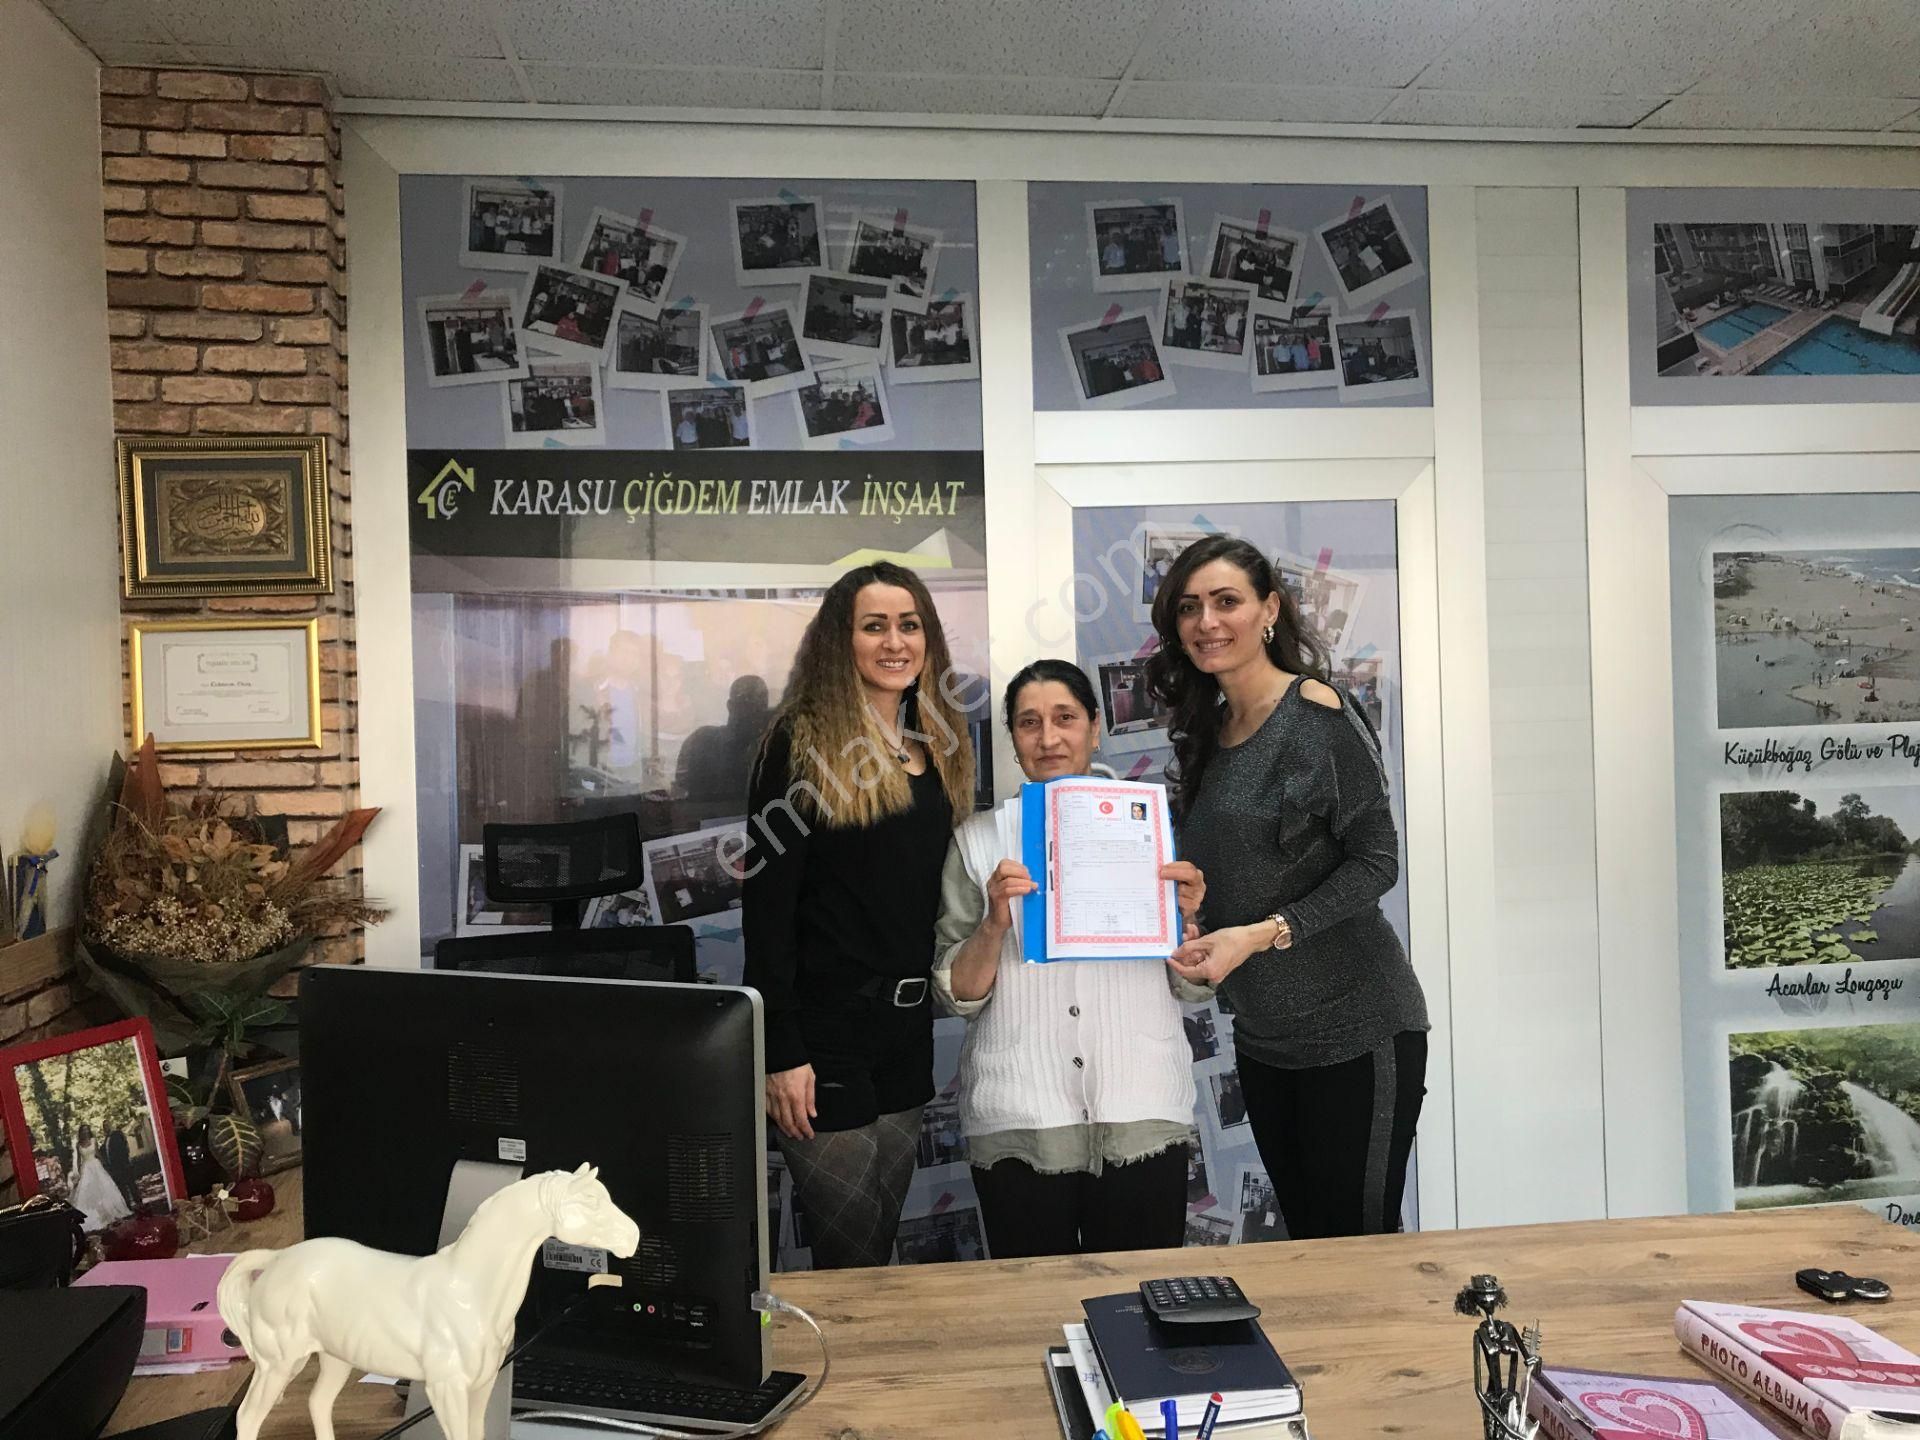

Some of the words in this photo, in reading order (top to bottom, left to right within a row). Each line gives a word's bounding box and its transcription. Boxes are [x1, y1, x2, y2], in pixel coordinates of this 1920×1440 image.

[490, 479, 614, 515] KARASU
[622, 473, 740, 524] ÇİĞDEM
[747, 480, 850, 515] EMLAK
[859, 474, 966, 525] İNŞAAT
[1724, 738, 1813, 773] Küçükboğaz
[1820, 737, 1862, 760] Gölü
[1866, 744, 1884, 759] ve
[1765, 972, 1830, 997] Acarlar
[1834, 968, 1904, 1001] Longozu
[1700, 1333, 1748, 1379] PHOTO
[1752, 1369, 1809, 1422] ALBUM
[1542, 1404, 1579, 1440] PHOT
